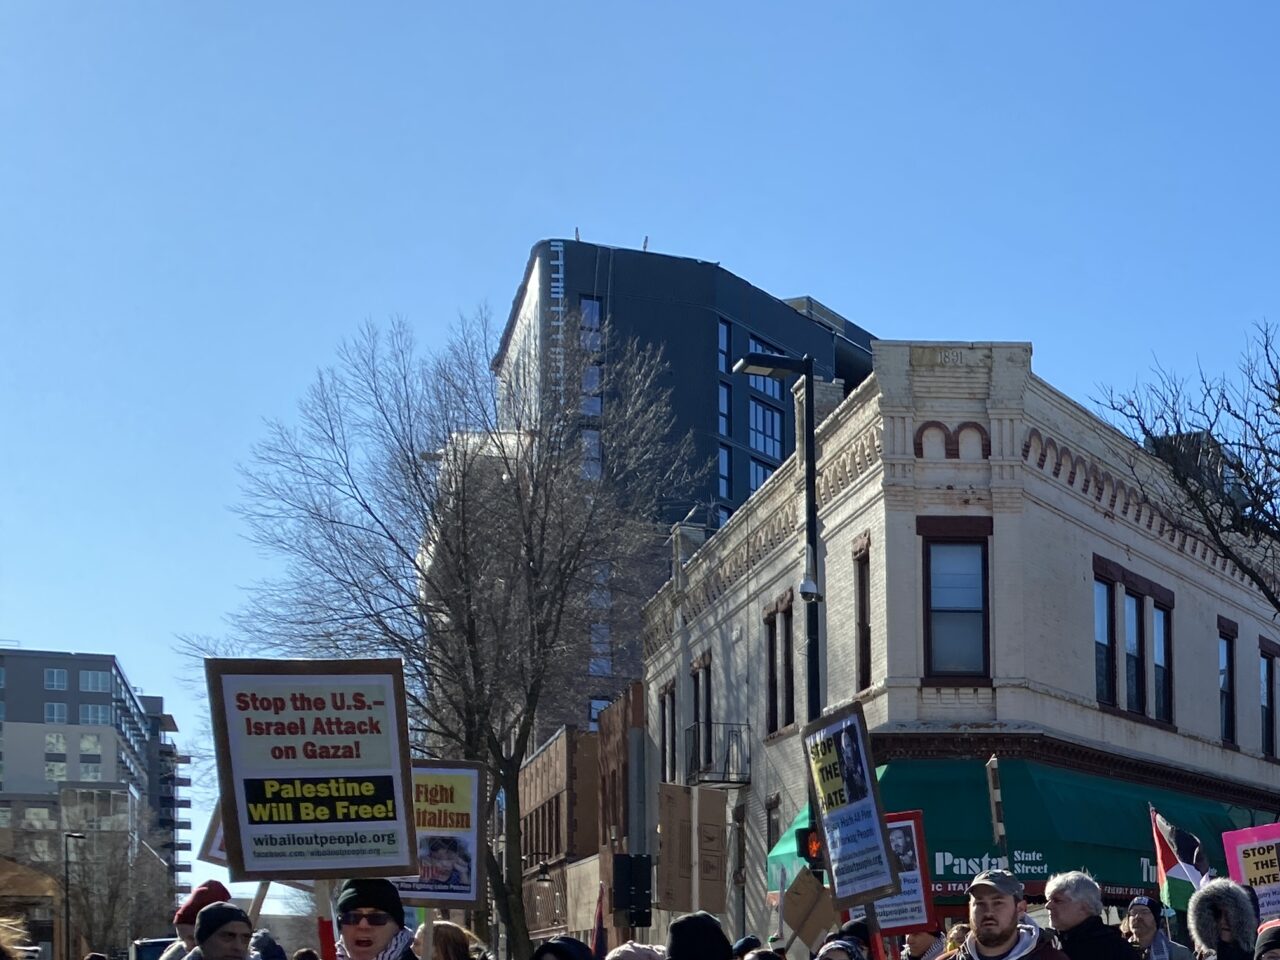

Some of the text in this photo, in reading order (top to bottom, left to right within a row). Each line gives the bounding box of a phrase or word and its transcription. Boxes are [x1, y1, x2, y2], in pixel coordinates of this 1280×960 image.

[235, 692, 286, 714] Stop
[290, 693, 326, 711] the
[245, 716, 382, 736] Israel Attack
[271, 741, 361, 760] on Gaza!
[819, 762, 841, 783] THE
[264, 778, 375, 798] Palestine
[415, 783, 455, 806] Fight
[248, 799, 394, 822] Will Be Free!
[416, 808, 471, 829] italism
[253, 831, 396, 847] wibailoutpeople.org
[1014, 850, 1043, 861] State
[1243, 844, 1275, 858] STOP
[935, 852, 1009, 875] Pasta
[1014, 863, 1048, 874] Street
[1254, 859, 1277, 871] THE
[1249, 873, 1280, 887] HATE
